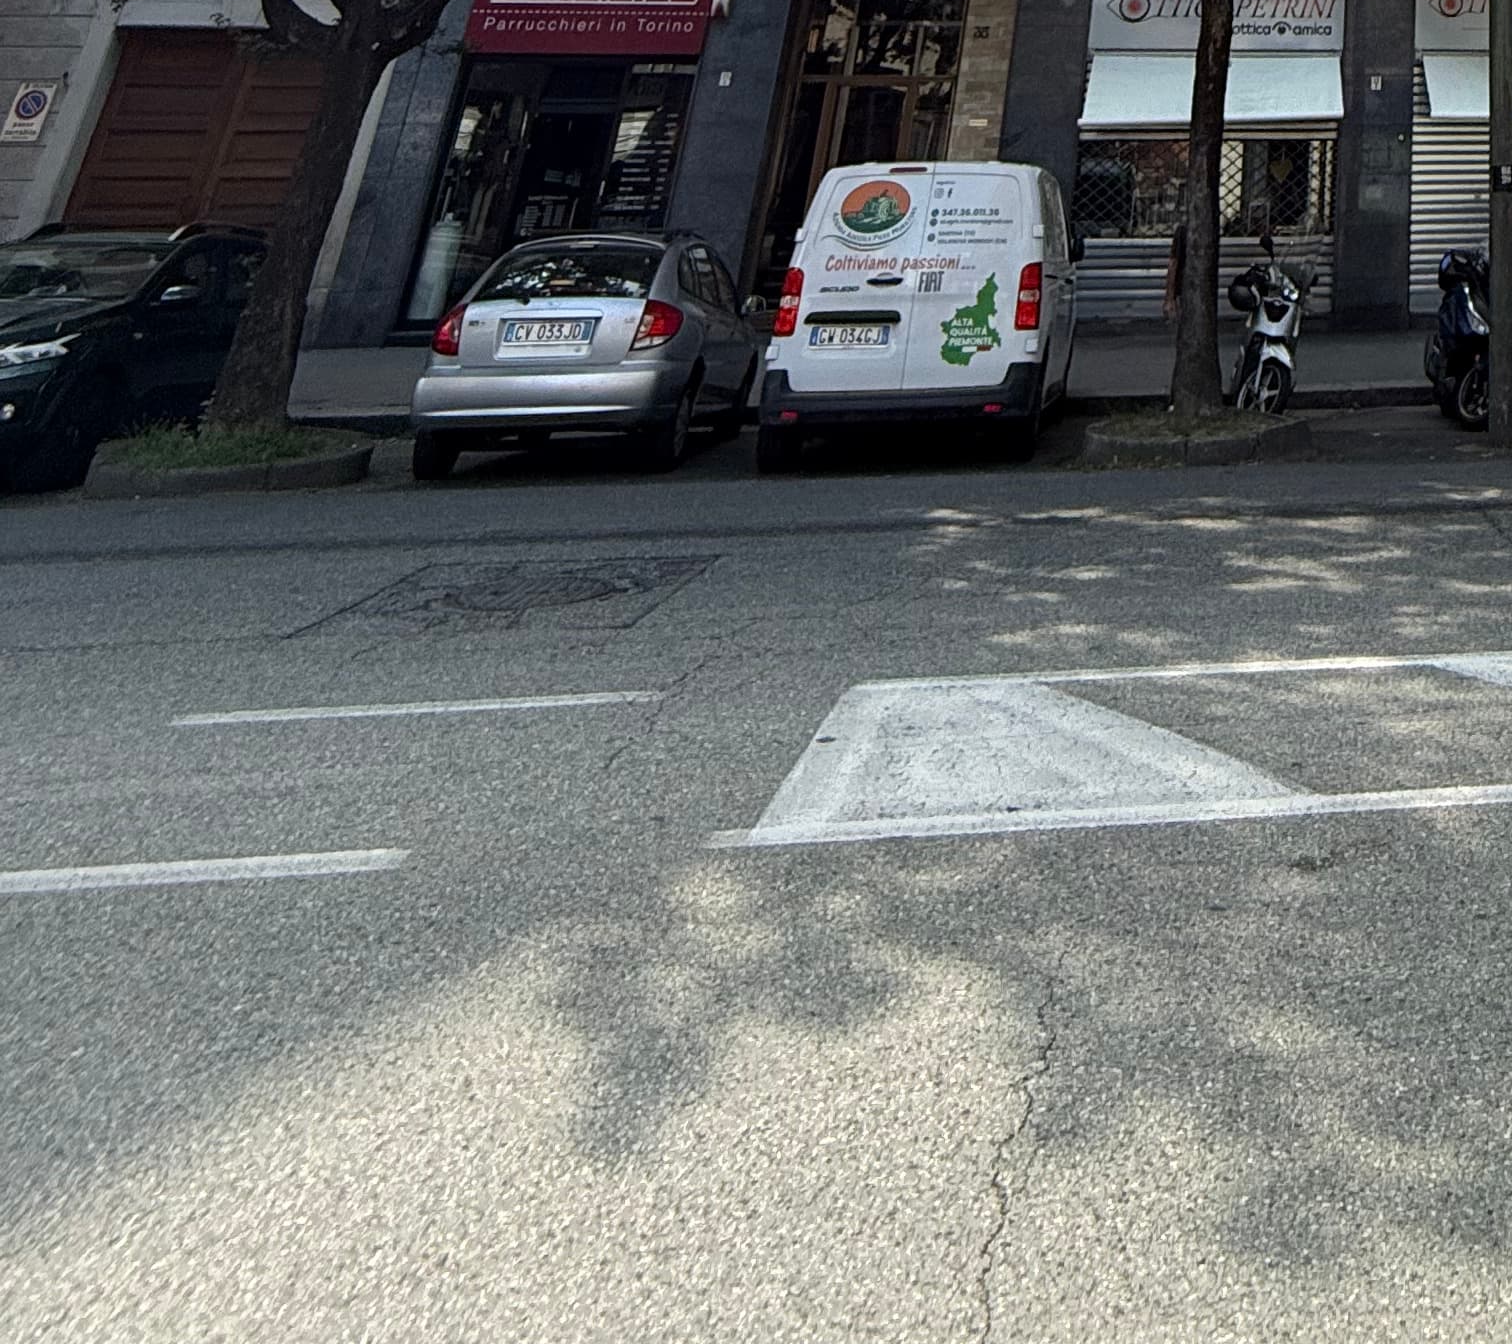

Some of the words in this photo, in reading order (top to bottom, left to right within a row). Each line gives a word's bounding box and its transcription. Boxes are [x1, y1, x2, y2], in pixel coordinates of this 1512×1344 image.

[483, 16, 601, 32] Parrucchieri
[610, 19, 626, 32] in
[638, 18, 694, 33] Torino
[1232, 23, 1272, 36] ottica
[1293, 23, 1332, 36] amica
[825, 254, 897, 271] Coltiviamo
[918, 270, 945, 293] FIAT
[951, 318, 974, 327] ALTA
[514, 324, 535, 341] CV
[537, 323, 582, 340] 033JD
[949, 336, 993, 346] PIEMONTE
